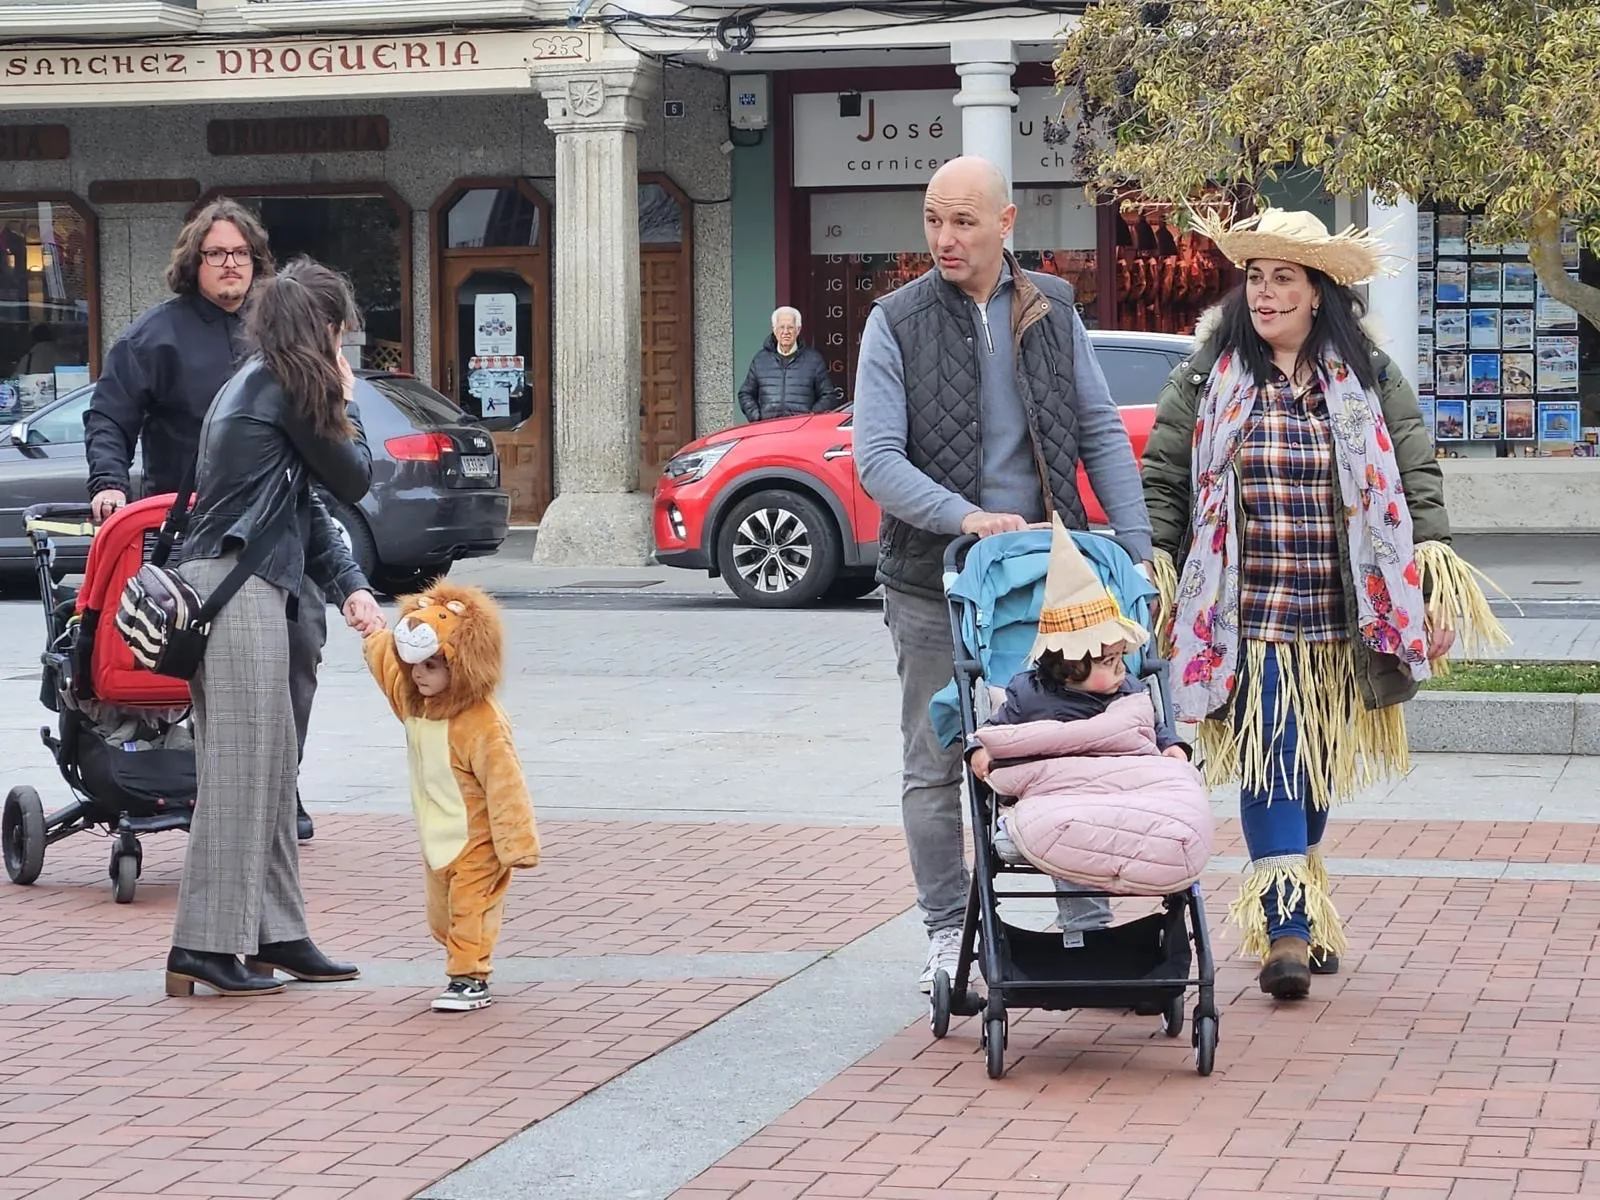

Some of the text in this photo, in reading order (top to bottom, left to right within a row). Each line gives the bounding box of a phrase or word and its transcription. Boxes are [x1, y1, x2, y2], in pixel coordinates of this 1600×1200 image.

[6, 53, 187, 77] SANCHEZ
[216, 40, 480, 75] DROGUERIA
[856, 99, 943, 142] José
[825, 224, 842, 237] JG
[826, 278, 843, 291] JG
[855, 279, 873, 291] JG
[826, 305, 843, 318] JG
[826, 332, 844, 345] JG
[828, 360, 844, 373] JG
